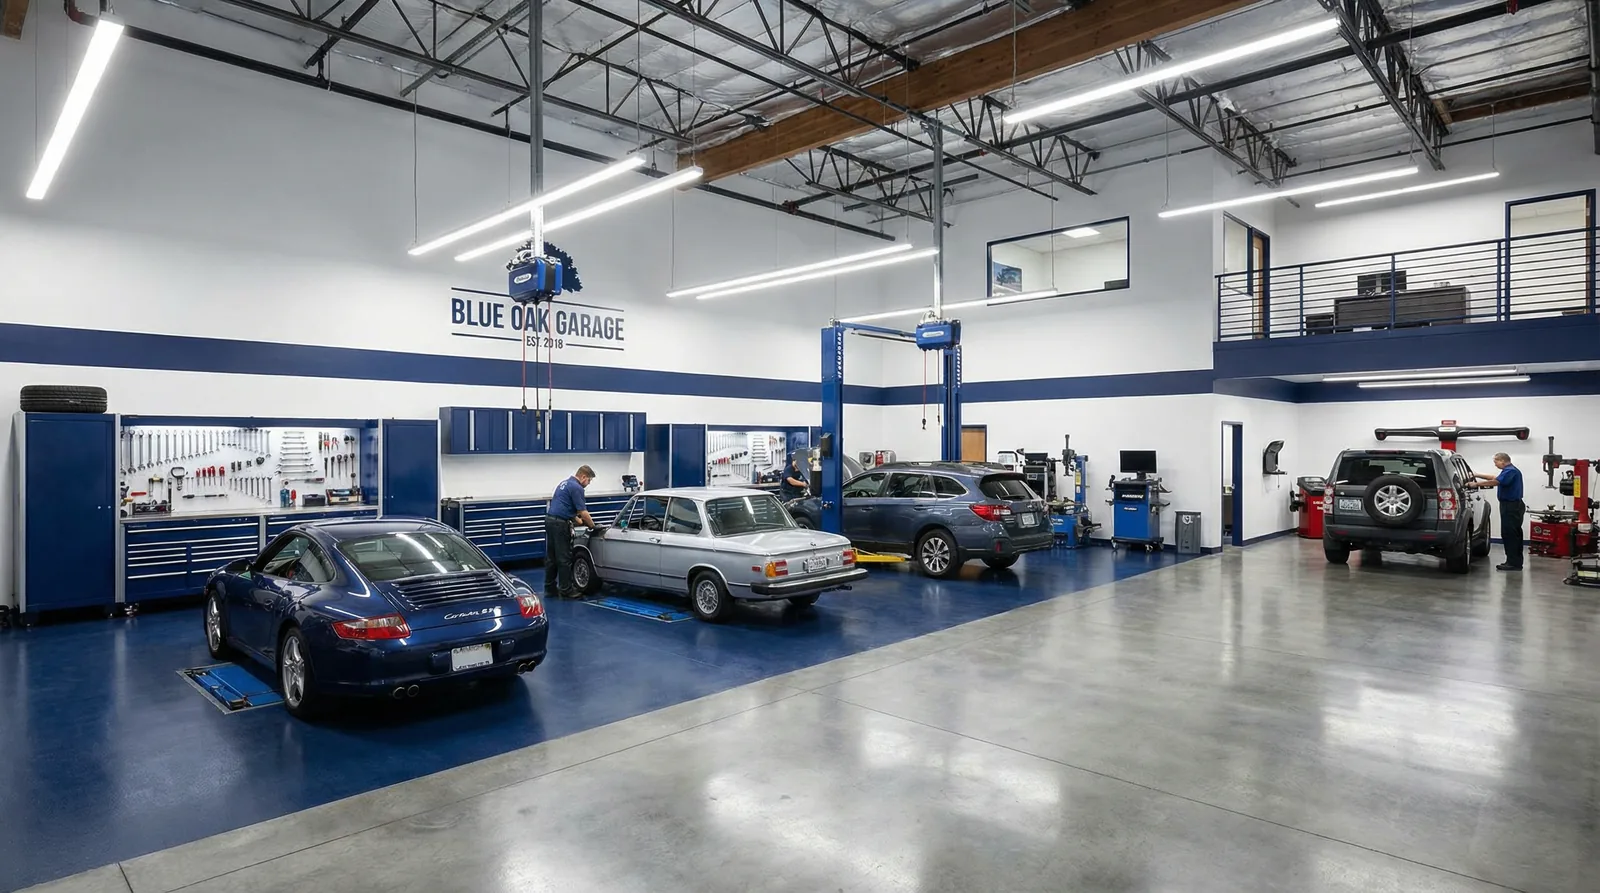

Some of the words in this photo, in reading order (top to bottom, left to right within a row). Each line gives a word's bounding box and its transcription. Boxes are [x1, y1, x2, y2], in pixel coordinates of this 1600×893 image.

[452, 298, 504, 328] BLUE
[511, 305, 549, 333] OAK
[556, 310, 624, 341] GARAGE
[526, 335, 542, 347] EST.
[543, 337, 563, 349] 2018
